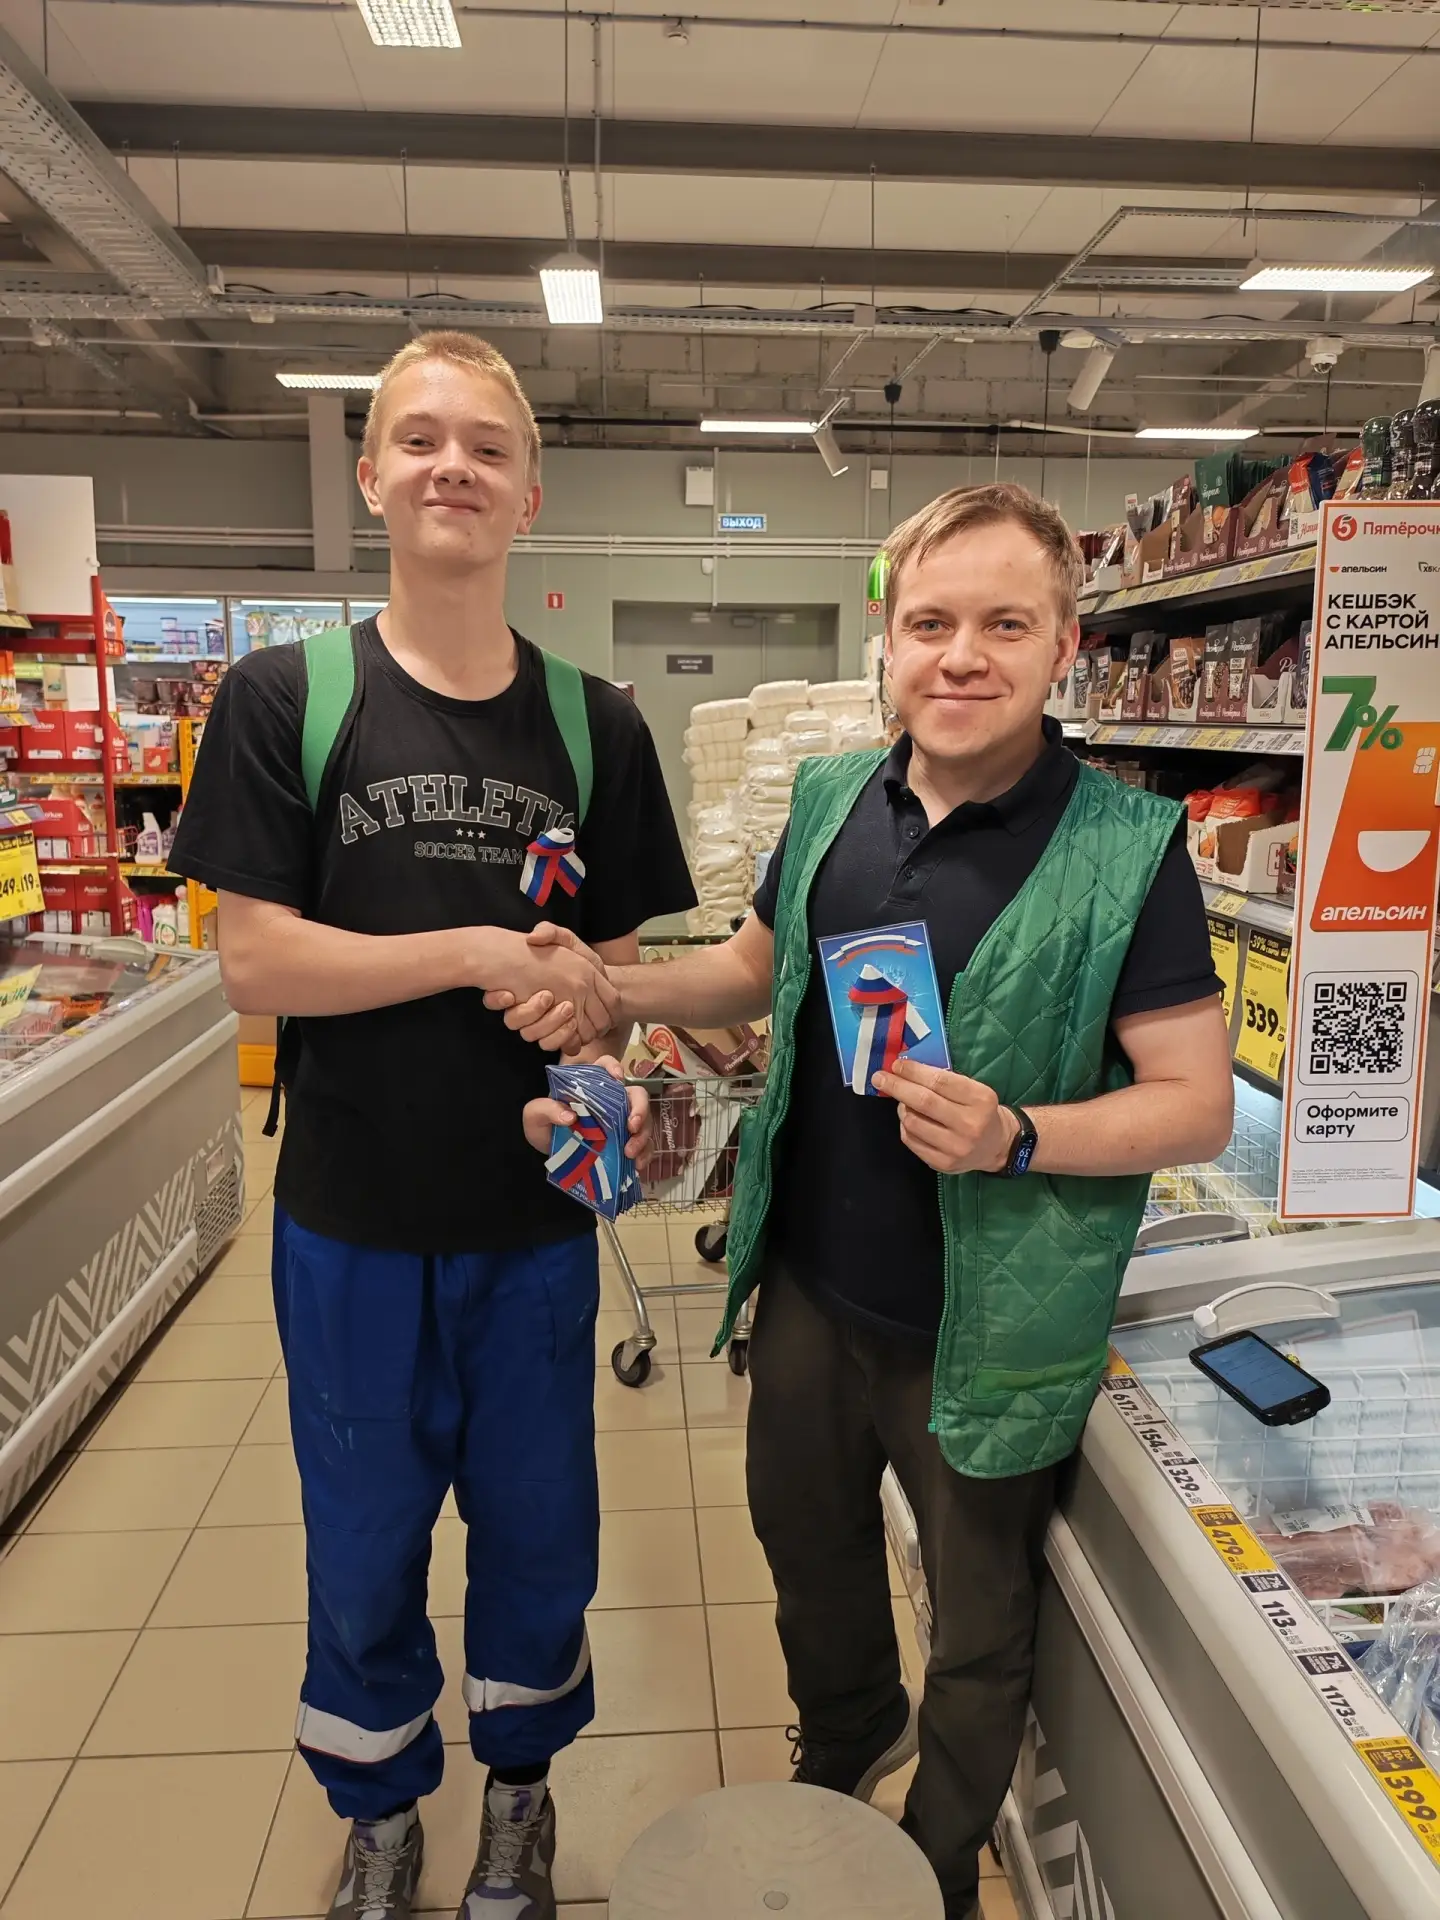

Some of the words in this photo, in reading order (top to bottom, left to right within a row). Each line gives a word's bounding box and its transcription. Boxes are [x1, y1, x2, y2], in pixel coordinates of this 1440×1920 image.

[722, 517, 762, 529] ВЫХОД
[1341, 565, 1387, 573] апельсин
[1328, 593, 1417, 609] КЕШБЭК
[1326, 614, 1341, 629] С
[1346, 610, 1429, 629] КАРТОЙ
[1324, 633, 1439, 649] АПЕЛЬСИН
[1322, 675, 1403, 751] 7%
[414, 841, 476, 861] SOCCER
[478, 848, 524, 865] TEAM
[1320, 904, 1427, 923] апельсин
[1246, 998, 1279, 1037] 339
[1307, 1104, 1399, 1121] Оформите
[1306, 1124, 1355, 1138] карту
[1113, 1393, 1139, 1414] 617
[1139, 1428, 1168, 1449] 154
[1168, 1468, 1200, 1492] 329
[1211, 1528, 1244, 1555] 479
[1261, 1600, 1297, 1628] 113
[1320, 1684, 1356, 1718] 1173
[1383, 1775, 1437, 1821] 399
